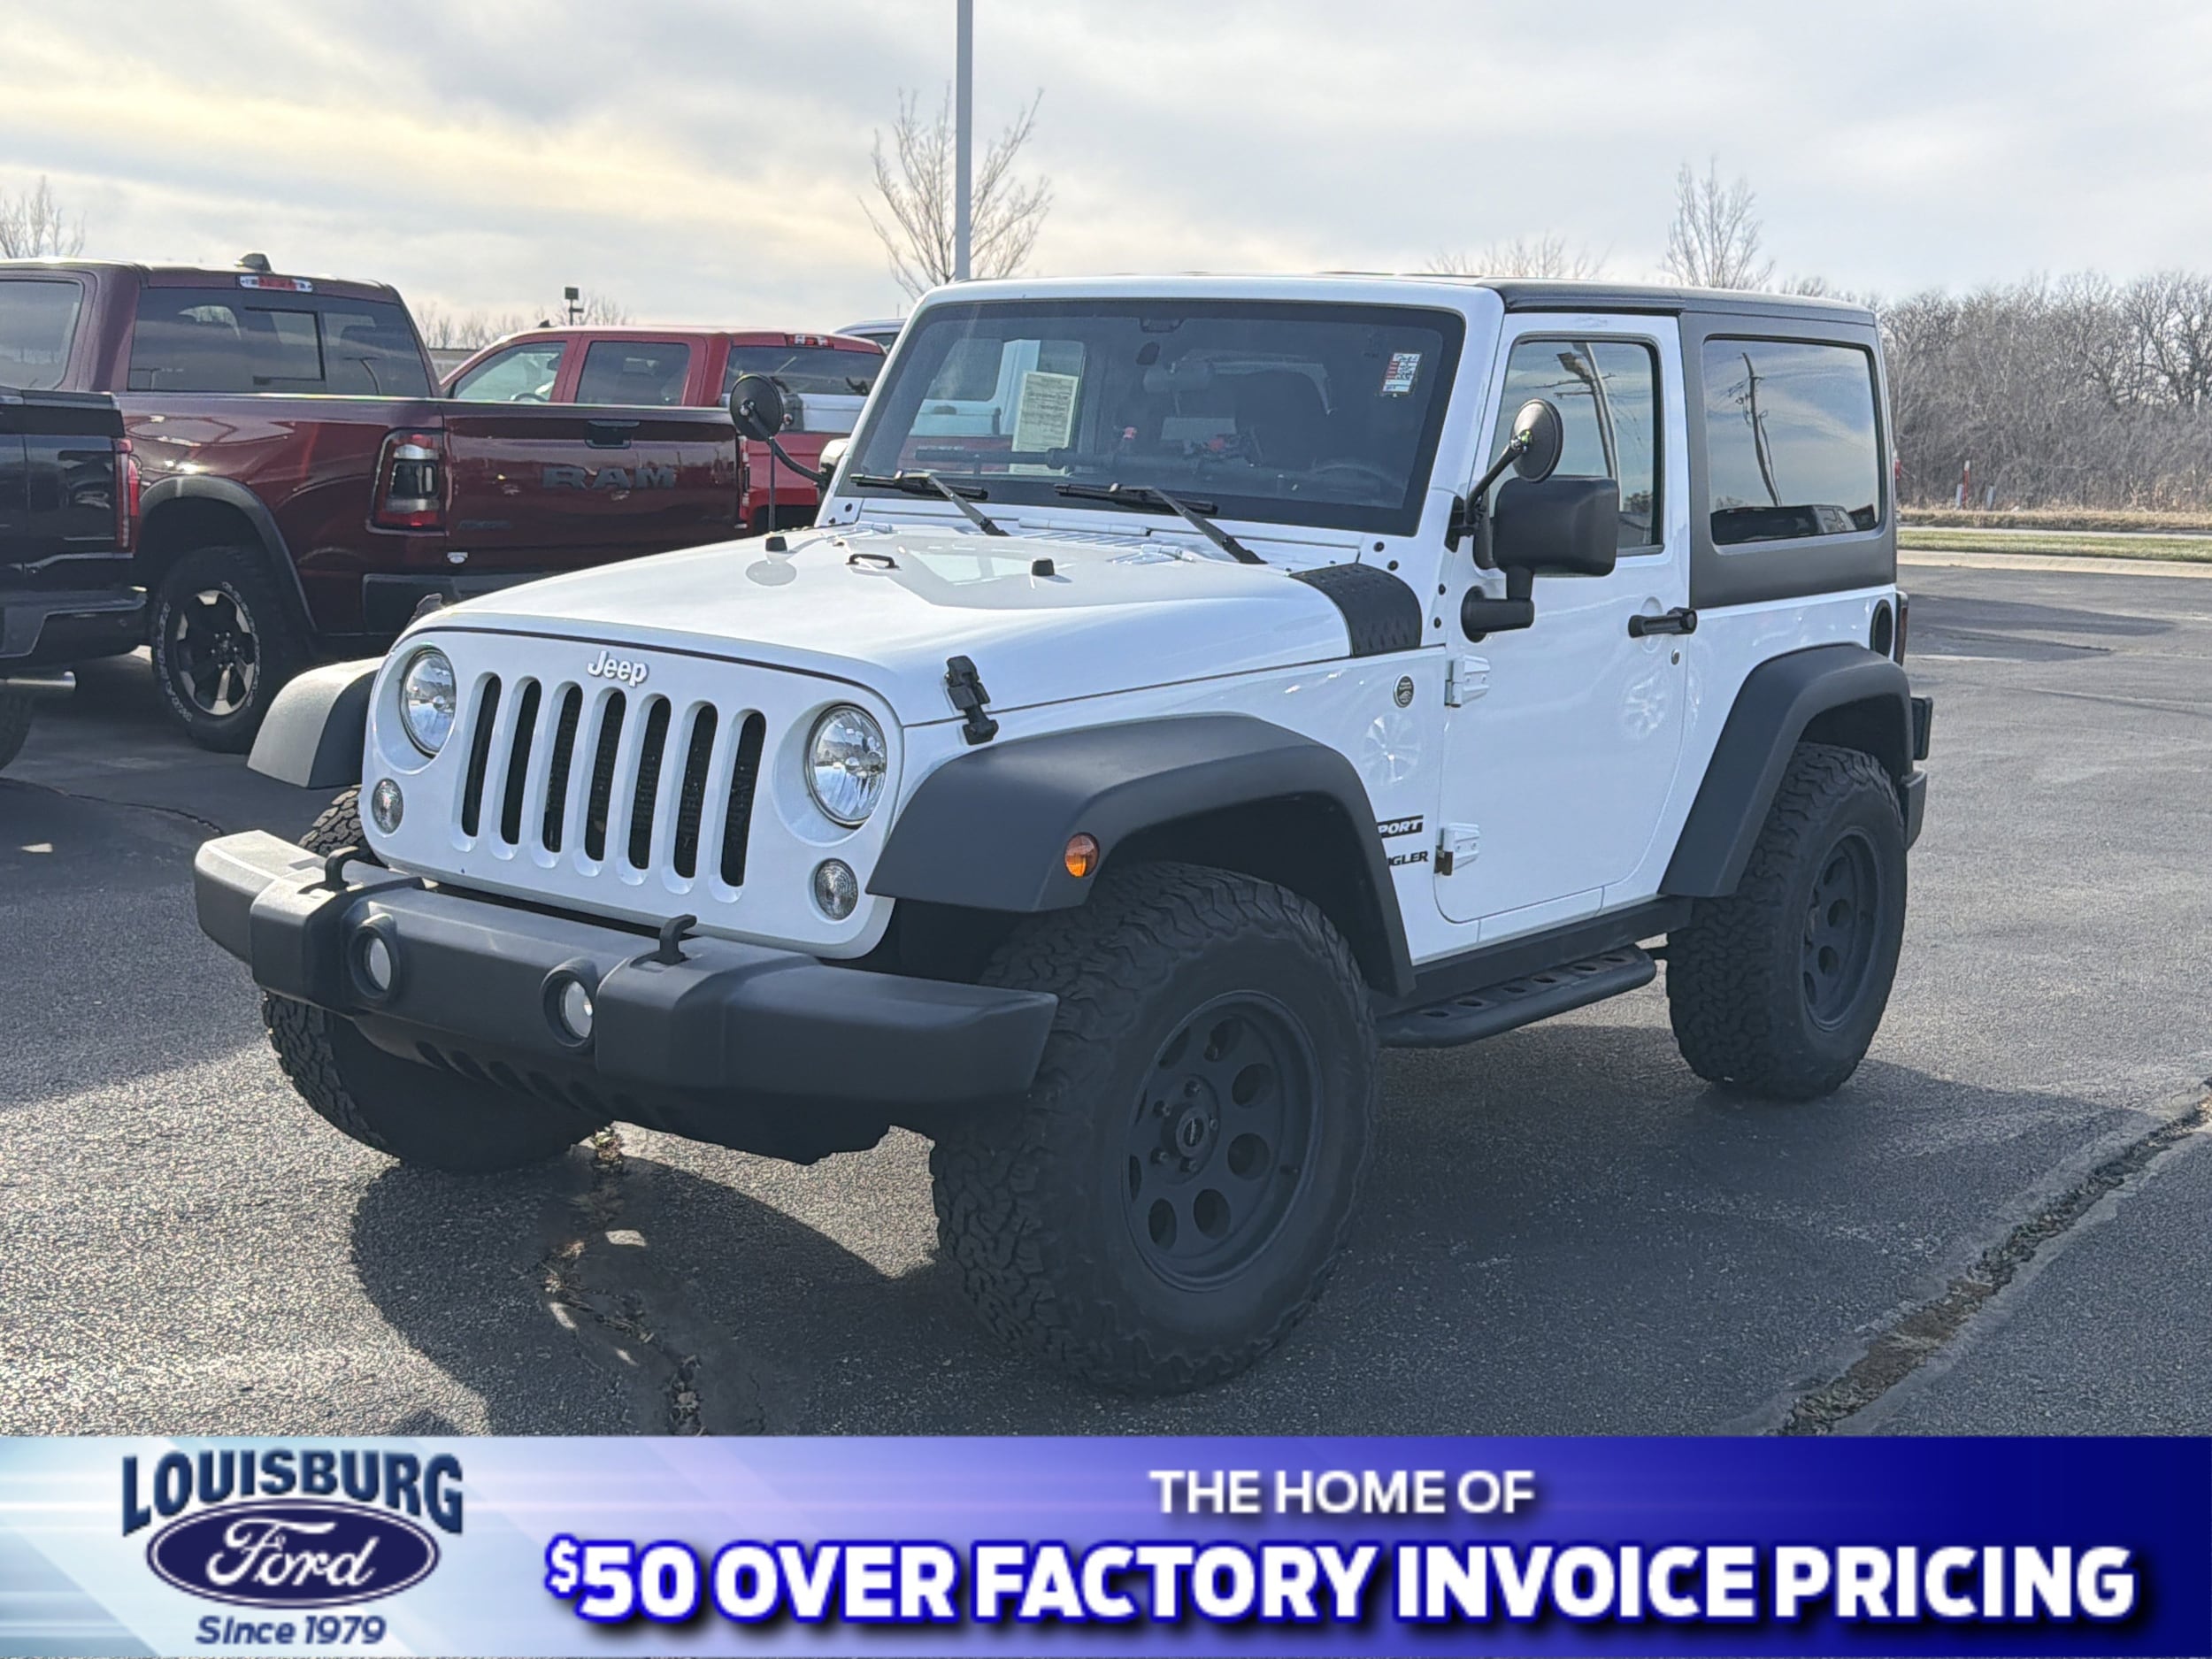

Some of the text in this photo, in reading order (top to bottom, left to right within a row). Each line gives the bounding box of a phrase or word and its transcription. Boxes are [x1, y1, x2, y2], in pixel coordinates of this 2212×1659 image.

[542, 466, 676, 489] RAM
[588, 650, 649, 687] Jeep
[1378, 818, 1423, 834] PORT
